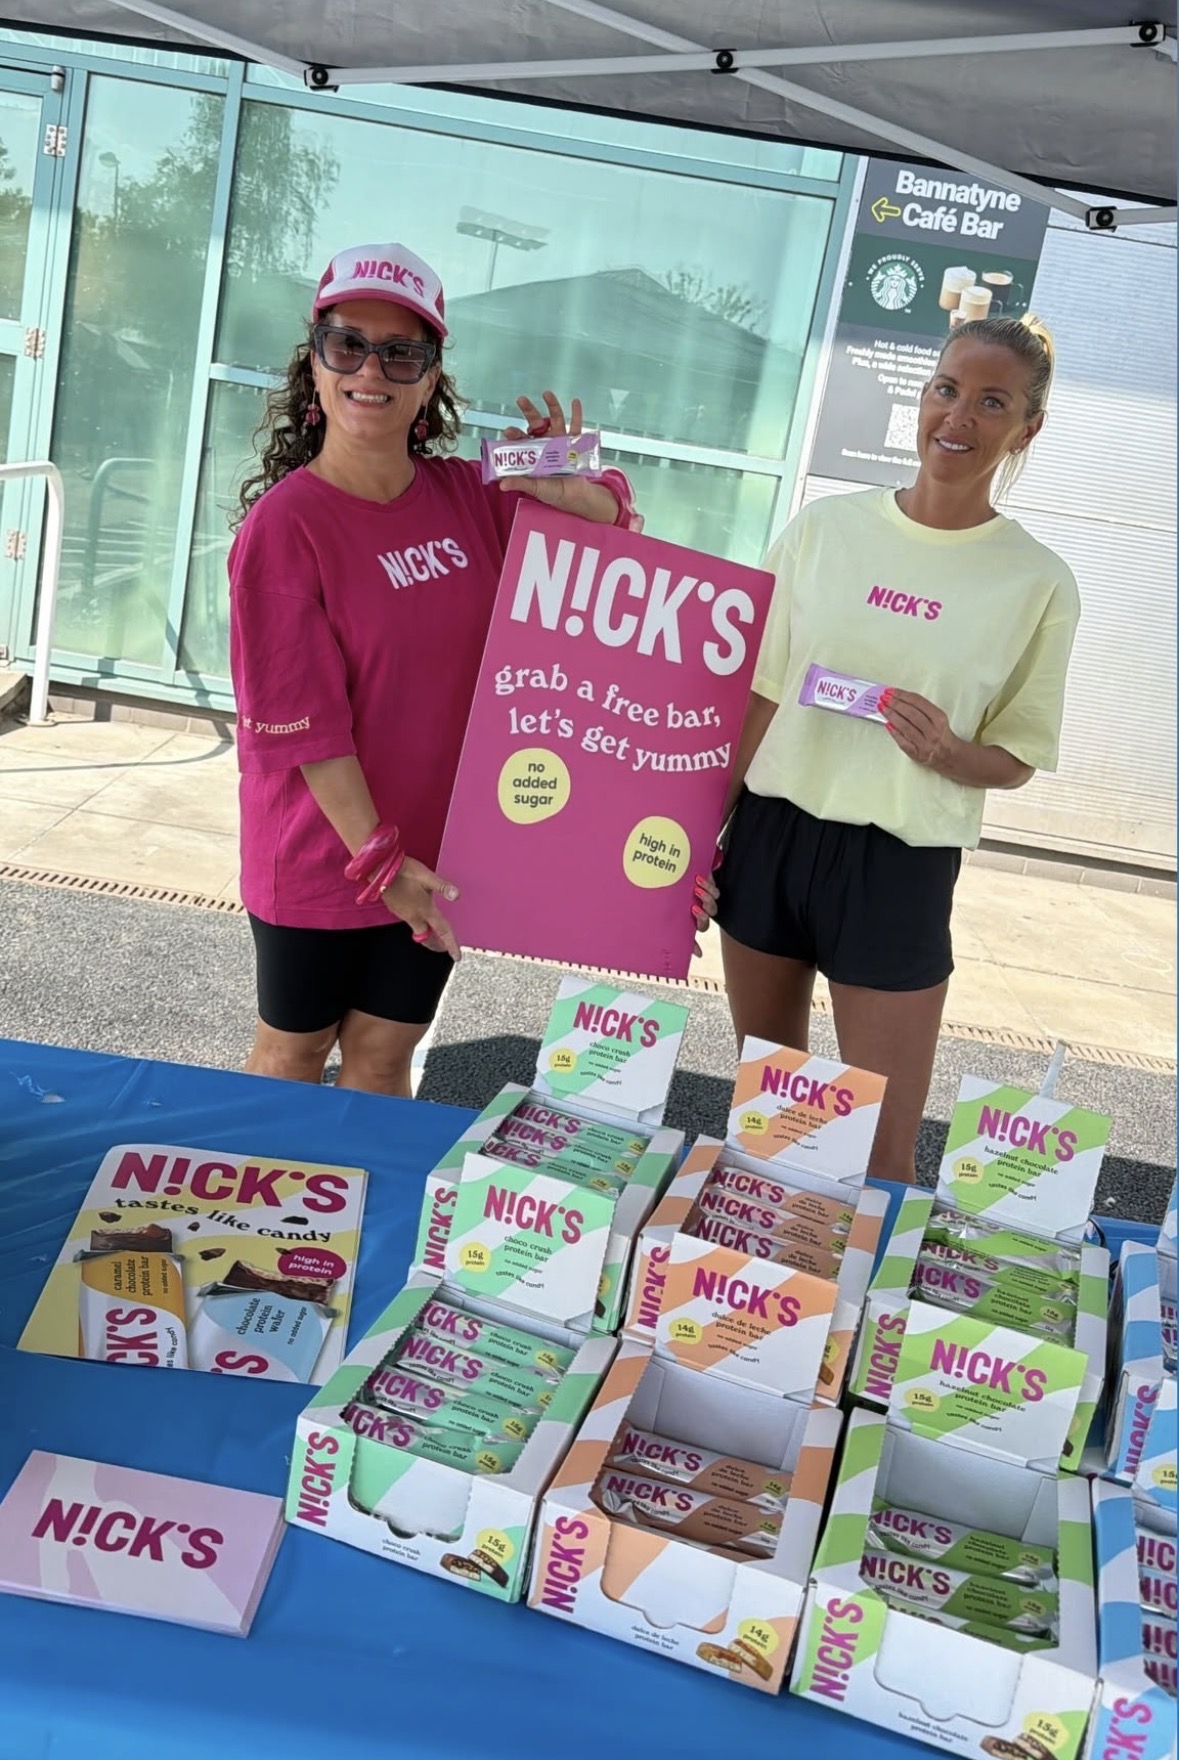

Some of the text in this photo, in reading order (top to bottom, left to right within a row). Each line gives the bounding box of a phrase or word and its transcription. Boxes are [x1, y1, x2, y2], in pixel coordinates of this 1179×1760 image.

[896, 170, 1020, 212] Bannatyne
[902, 203, 1003, 240] Café Bar
[878, 254, 910, 264] PROUDLY
[846, 345, 874, 359] Freshly
[874, 340, 888, 350] Hot
[890, 342, 895, 350] &
[897, 344, 913, 353] cold
[914, 346, 932, 356] food
[878, 374, 898, 385] Open
[494, 663, 721, 729] grab a free bar,
[255, 717, 309, 733] yummy
[509, 707, 731, 772] let's get yummy
[527, 762, 545, 773] no
[512, 775, 557, 789] added
[513, 792, 554, 807] sugar
[638, 832, 680, 858] high in
[632, 849, 677, 873] protein
[588, 1049, 627, 1064] protein bar
[590, 1040, 631, 1057] choco crush
[556, 1054, 571, 1064] 15g
[747, 1116, 762, 1126] 14g
[776, 1105, 795, 1116] dulce
[808, 1114, 828, 1126] leche
[780, 1113, 822, 1130] protein bar
[961, 1163, 977, 1173] 15g
[984, 1146, 1059, 1175] hazelnut chocolate
[998, 1159, 1042, 1178] protein bar
[115, 1198, 331, 1242] tastes like candy
[504, 1235, 552, 1255] choco crush
[504, 1244, 549, 1262] protein bar
[293, 1254, 334, 1268] high in
[468, 1250, 484, 1260] 15g
[781, 1256, 806, 1270] protein
[113, 1261, 122, 1291] caramel
[128, 1258, 136, 1294] chocolate
[288, 1261, 332, 1276] protein
[142, 1272, 151, 1296] protein
[237, 1298, 261, 1336] chocolate
[256, 1304, 273, 1334] protein
[269, 1309, 285, 1333] wafer
[712, 1312, 772, 1335] dulce de leche
[677, 1324, 694, 1334] 14g
[716, 1321, 763, 1340] protein bar
[488, 1337, 528, 1356] protein bar
[489, 1331, 532, 1351] choco crush
[489, 1377, 531, 1397] protein bar
[490, 1371, 535, 1392] choco crush
[912, 1400, 934, 1408] protein
[914, 1394, 933, 1402] 15g
[939, 1380, 1027, 1413] hazelnut chocolate
[955, 1393, 1006, 1413] protein bar
[451, 1404, 496, 1423] protein bar
[422, 1441, 450, 1455] protein
[452, 1449, 468, 1460] bar
[483, 1454, 497, 1466] 15g
[711, 1472, 738, 1485] protein
[481, 1542, 504, 1558] protein
[487, 1534, 506, 1551] 15g
[632, 1624, 650, 1634] dulce
[662, 1633, 680, 1646] leche
[634, 1633, 674, 1650] protein bar
[742, 1632, 768, 1650] protein
[748, 1624, 770, 1642] 14g
[898, 1712, 968, 1741] hazelnut chocolate
[910, 1723, 953, 1743] protein bar
[1035, 1718, 1059, 1738] 15g
